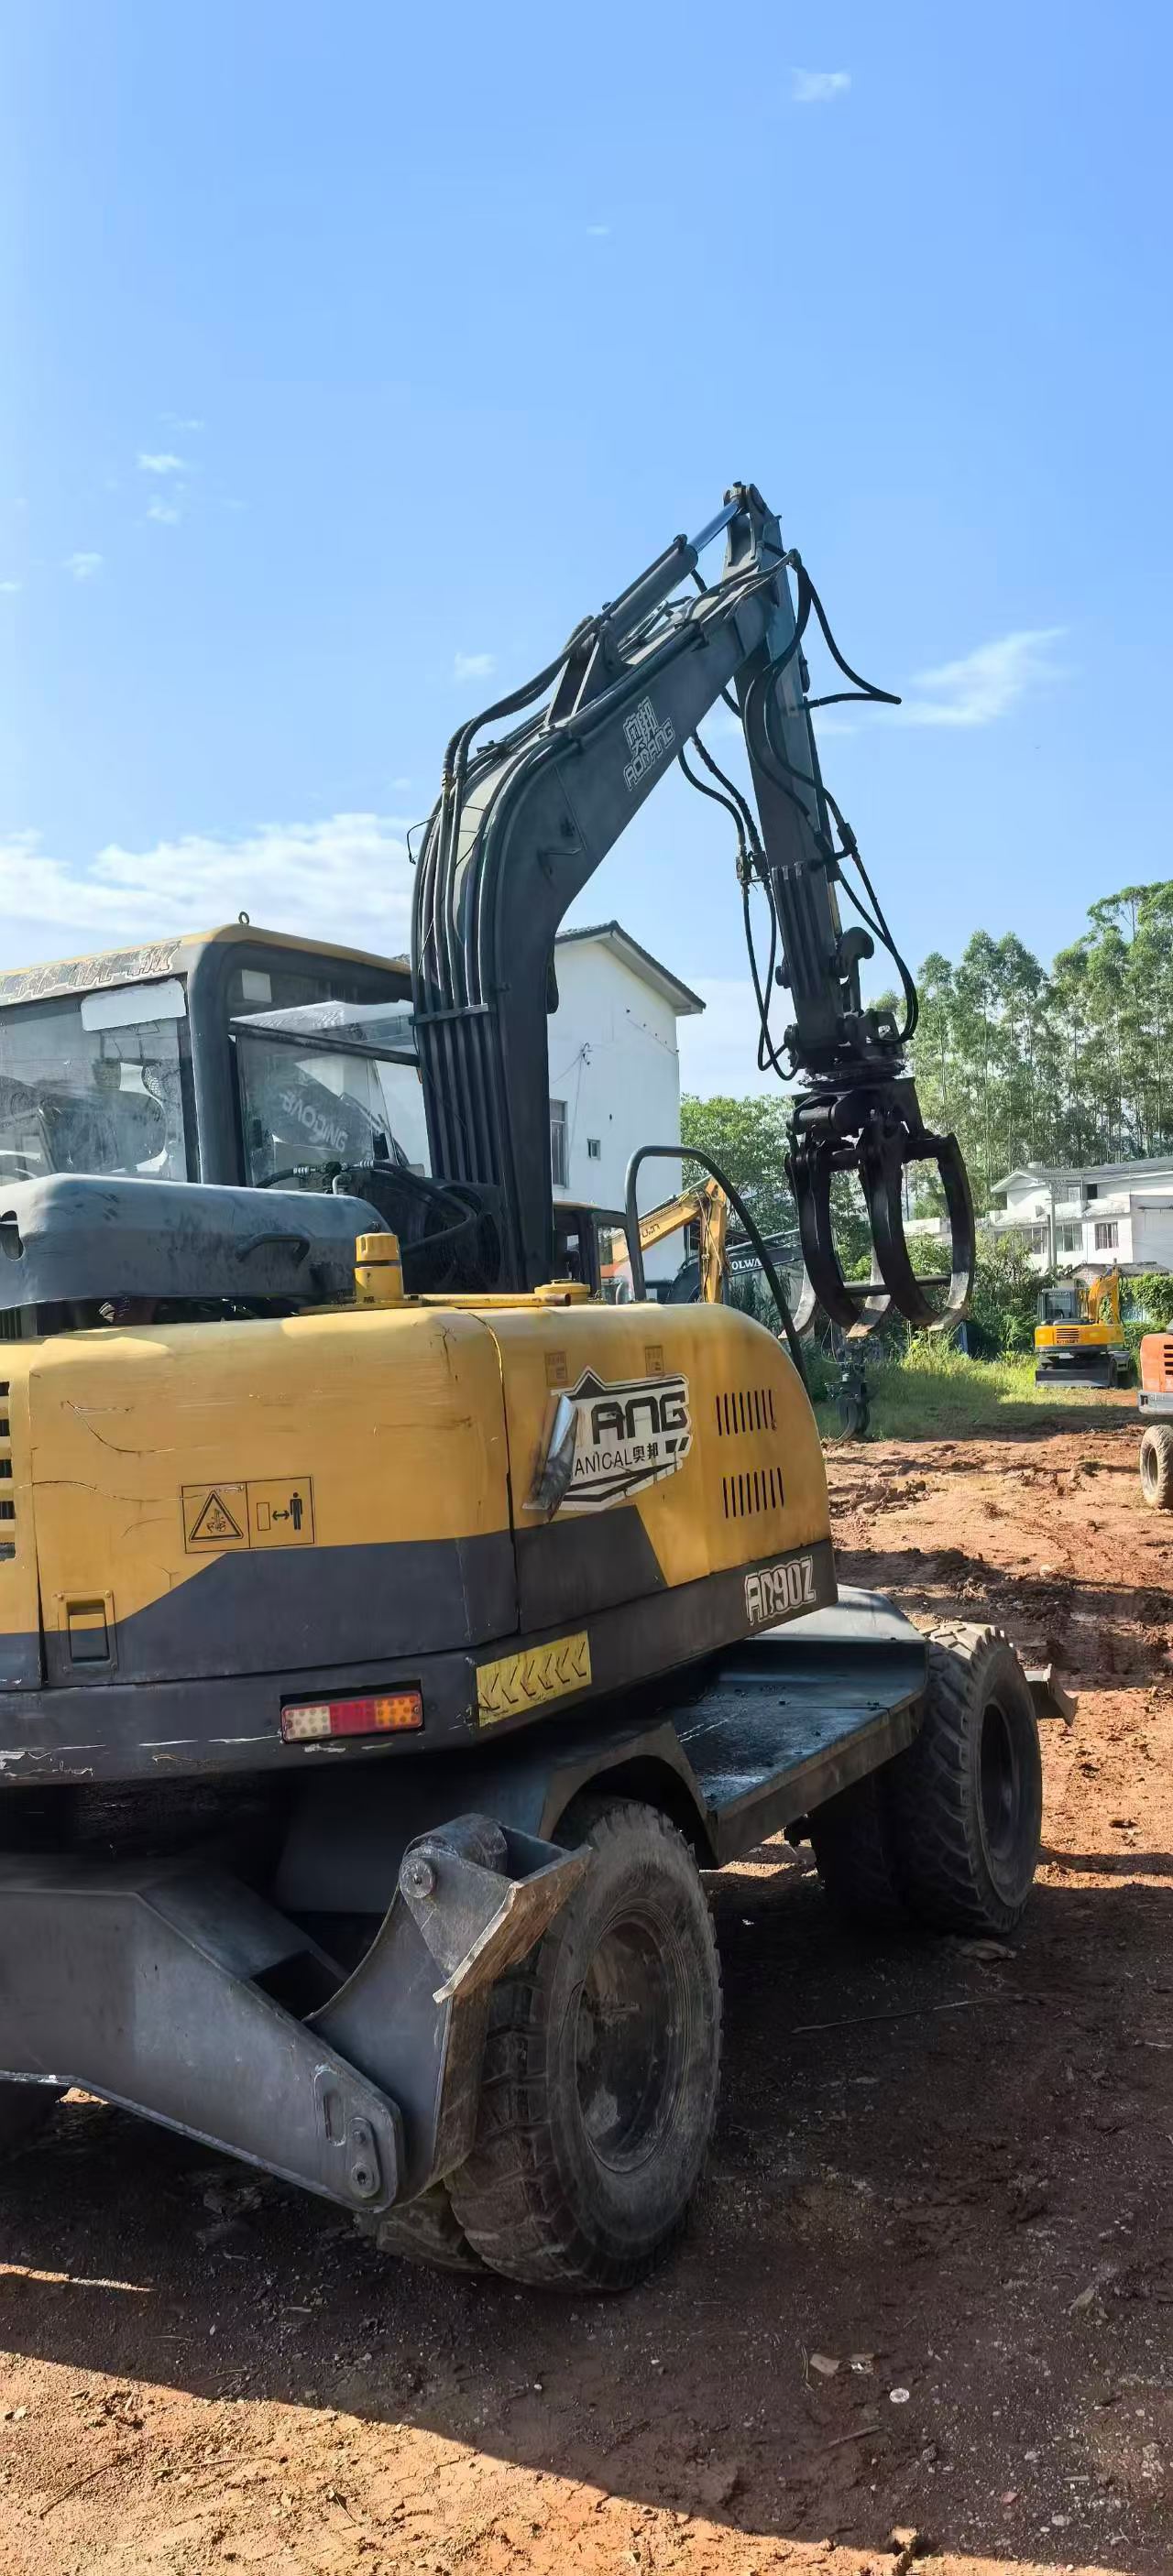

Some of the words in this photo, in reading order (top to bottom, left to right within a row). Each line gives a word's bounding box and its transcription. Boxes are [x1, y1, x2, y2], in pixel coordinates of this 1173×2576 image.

[729, 1258, 762, 1271] OLWA
[591, 1391, 688, 1446] ANG
[574, 1447, 633, 1477] ANICAL
